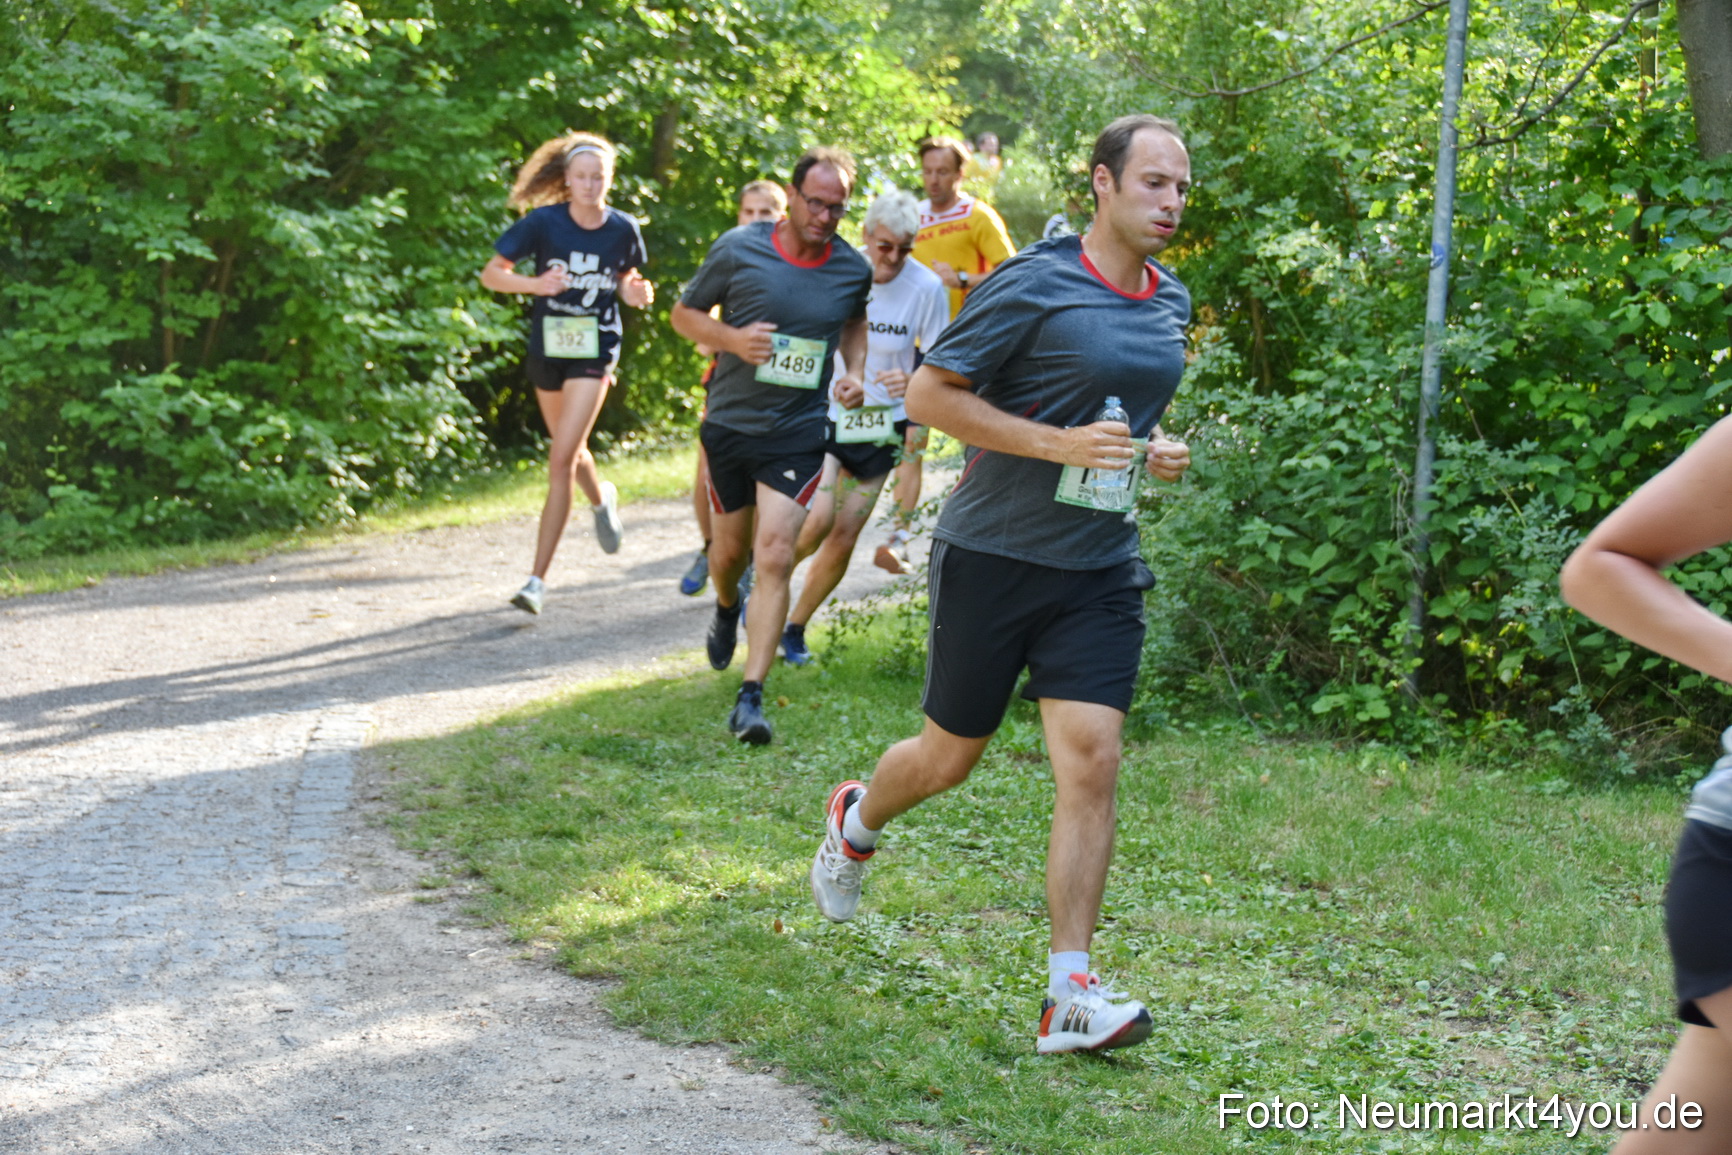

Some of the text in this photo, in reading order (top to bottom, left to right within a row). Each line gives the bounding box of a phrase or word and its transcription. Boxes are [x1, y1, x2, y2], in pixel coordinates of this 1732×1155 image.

[867, 320, 909, 336] AGNA
[770, 352, 816, 374] 1489
[844, 411, 885, 430] 2434
[1079, 465, 1137, 492] 11
